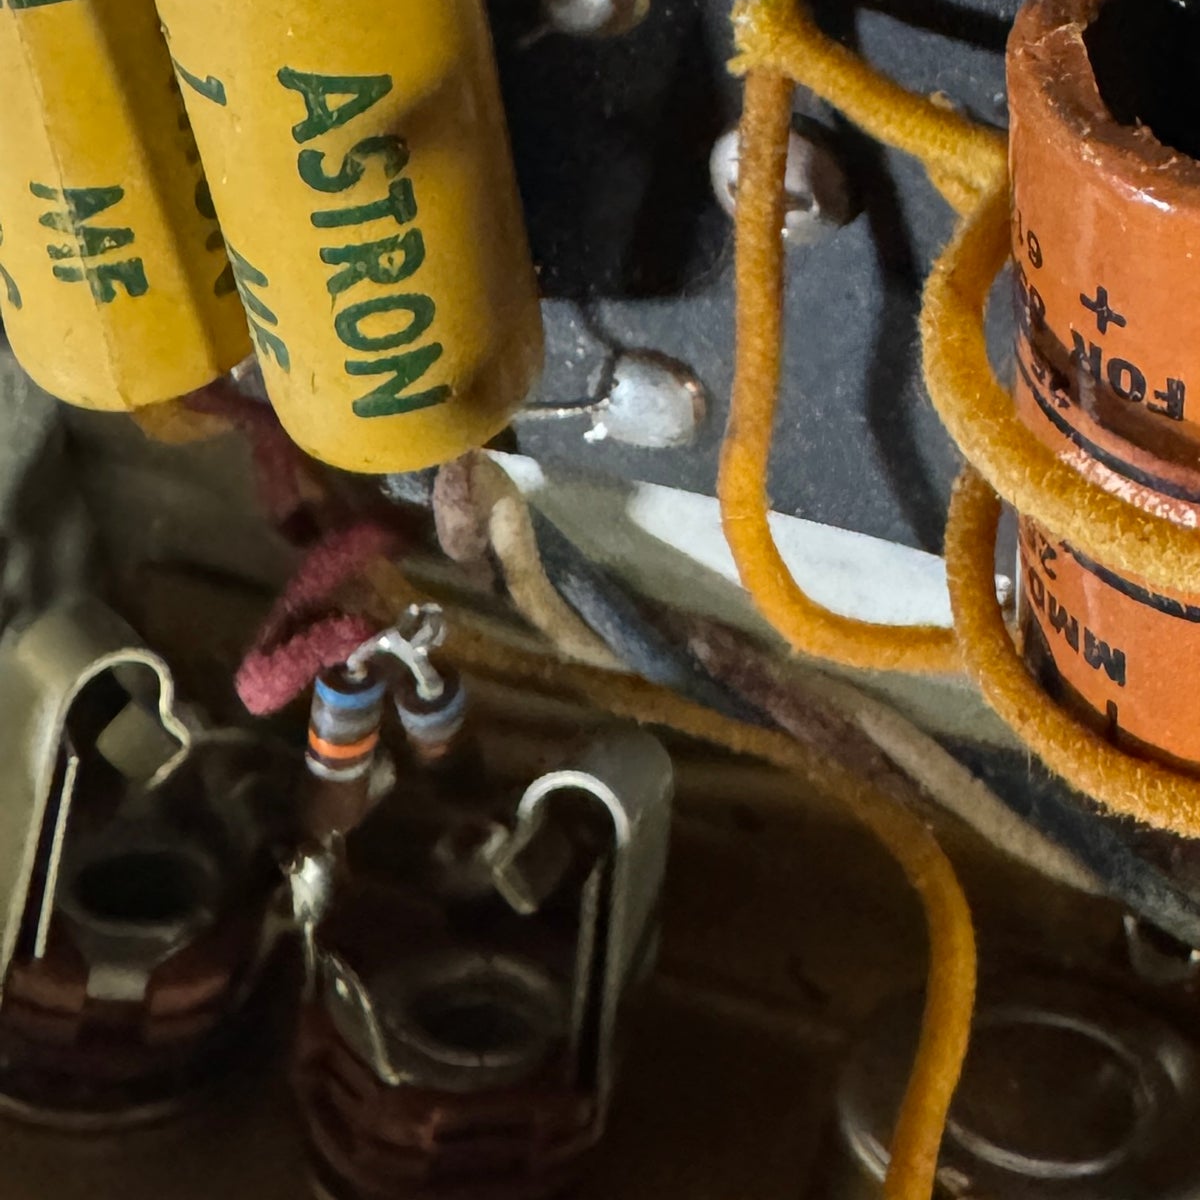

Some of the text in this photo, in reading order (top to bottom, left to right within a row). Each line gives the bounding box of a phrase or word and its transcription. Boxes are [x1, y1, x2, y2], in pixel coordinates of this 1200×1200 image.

[30, 181, 149, 303] MF
[276, 66, 453, 419] ASTRON
[1070, 327, 1186, 422] FOR
